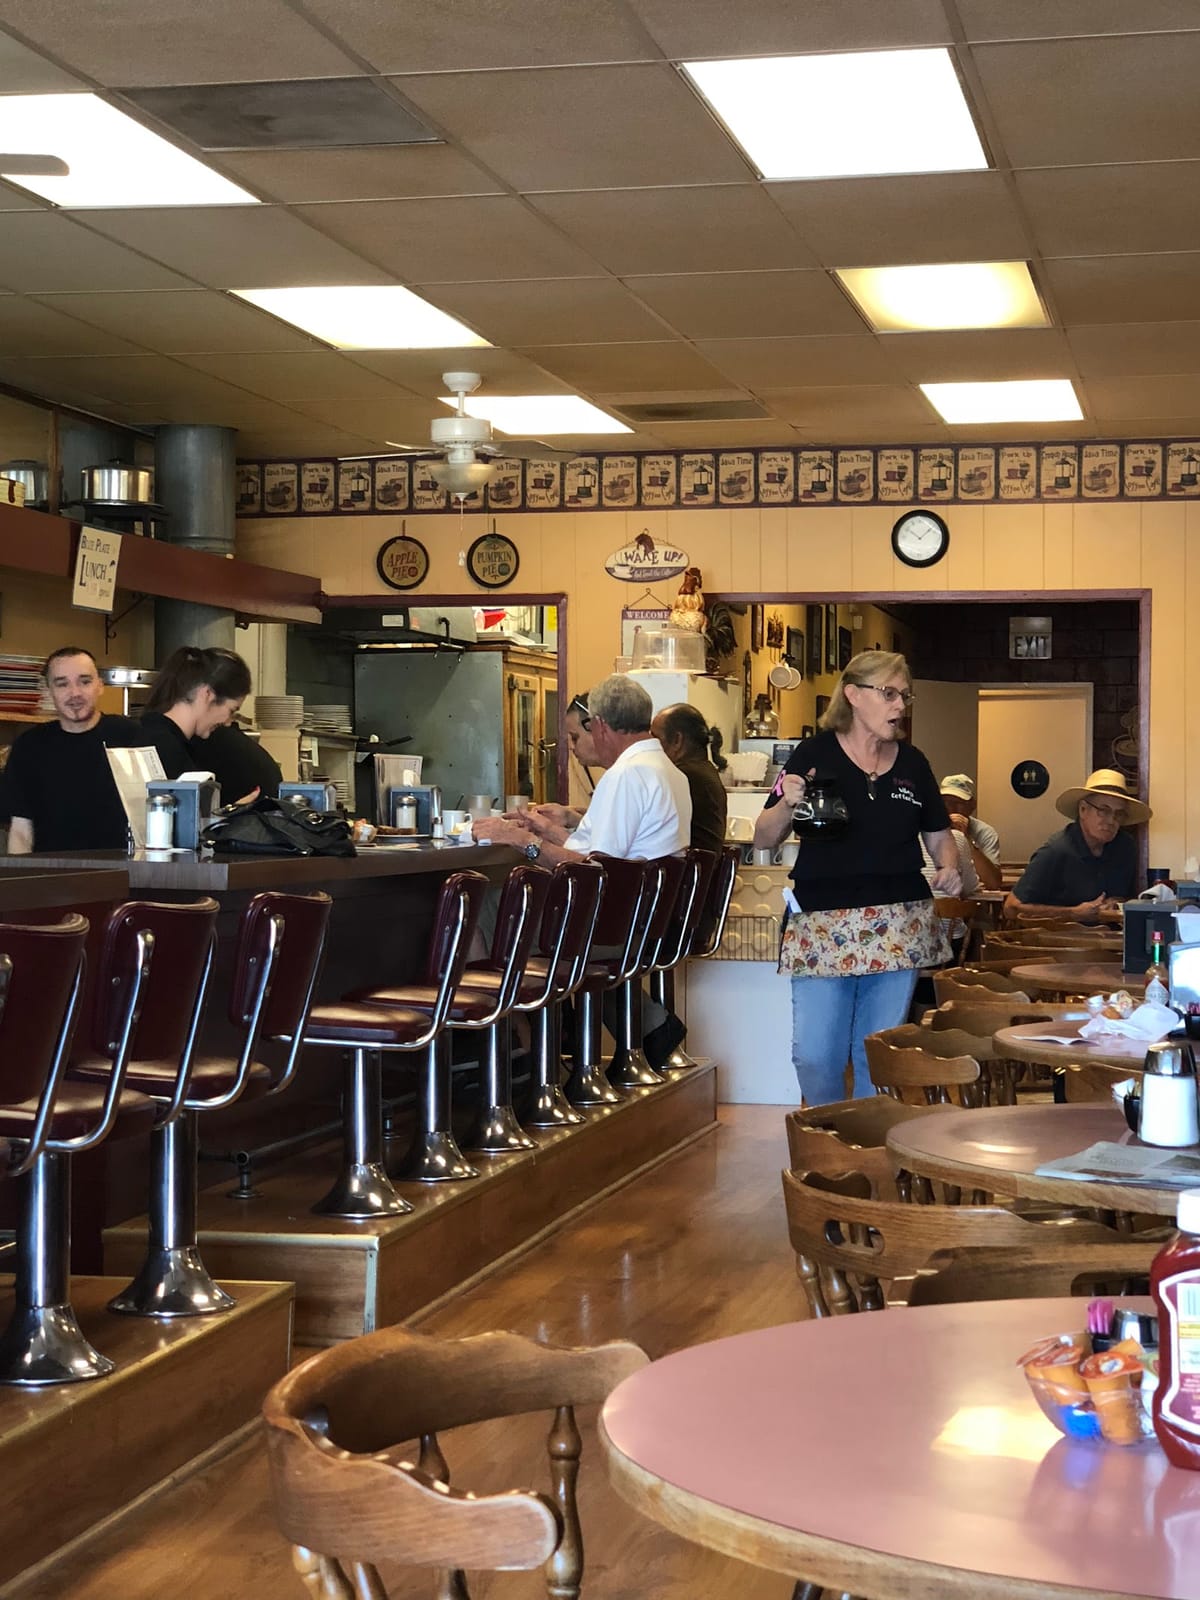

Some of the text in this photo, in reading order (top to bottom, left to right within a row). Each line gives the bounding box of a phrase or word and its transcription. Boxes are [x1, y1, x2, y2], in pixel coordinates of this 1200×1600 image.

[976, 452, 994, 460] Time
[1100, 448, 1118, 457] Time
[736, 456, 752, 465] Time
[856, 454, 872, 462] Time
[392, 464, 407, 472] Time
[505, 462, 520, 470] Time
[619, 460, 635, 468] Time
[280, 467, 296, 476] Time
[387, 551, 418, 568] APPLE
[477, 550, 512, 564] PUMPKIN
[624, 550, 684, 566] WAKE UP!
[79, 554, 108, 587] LUNCH
[392, 566, 409, 578] PIE
[482, 564, 497, 576] PIE
[626, 610, 670, 620] WELCOME
[1014, 636, 1049, 657] EXIT
